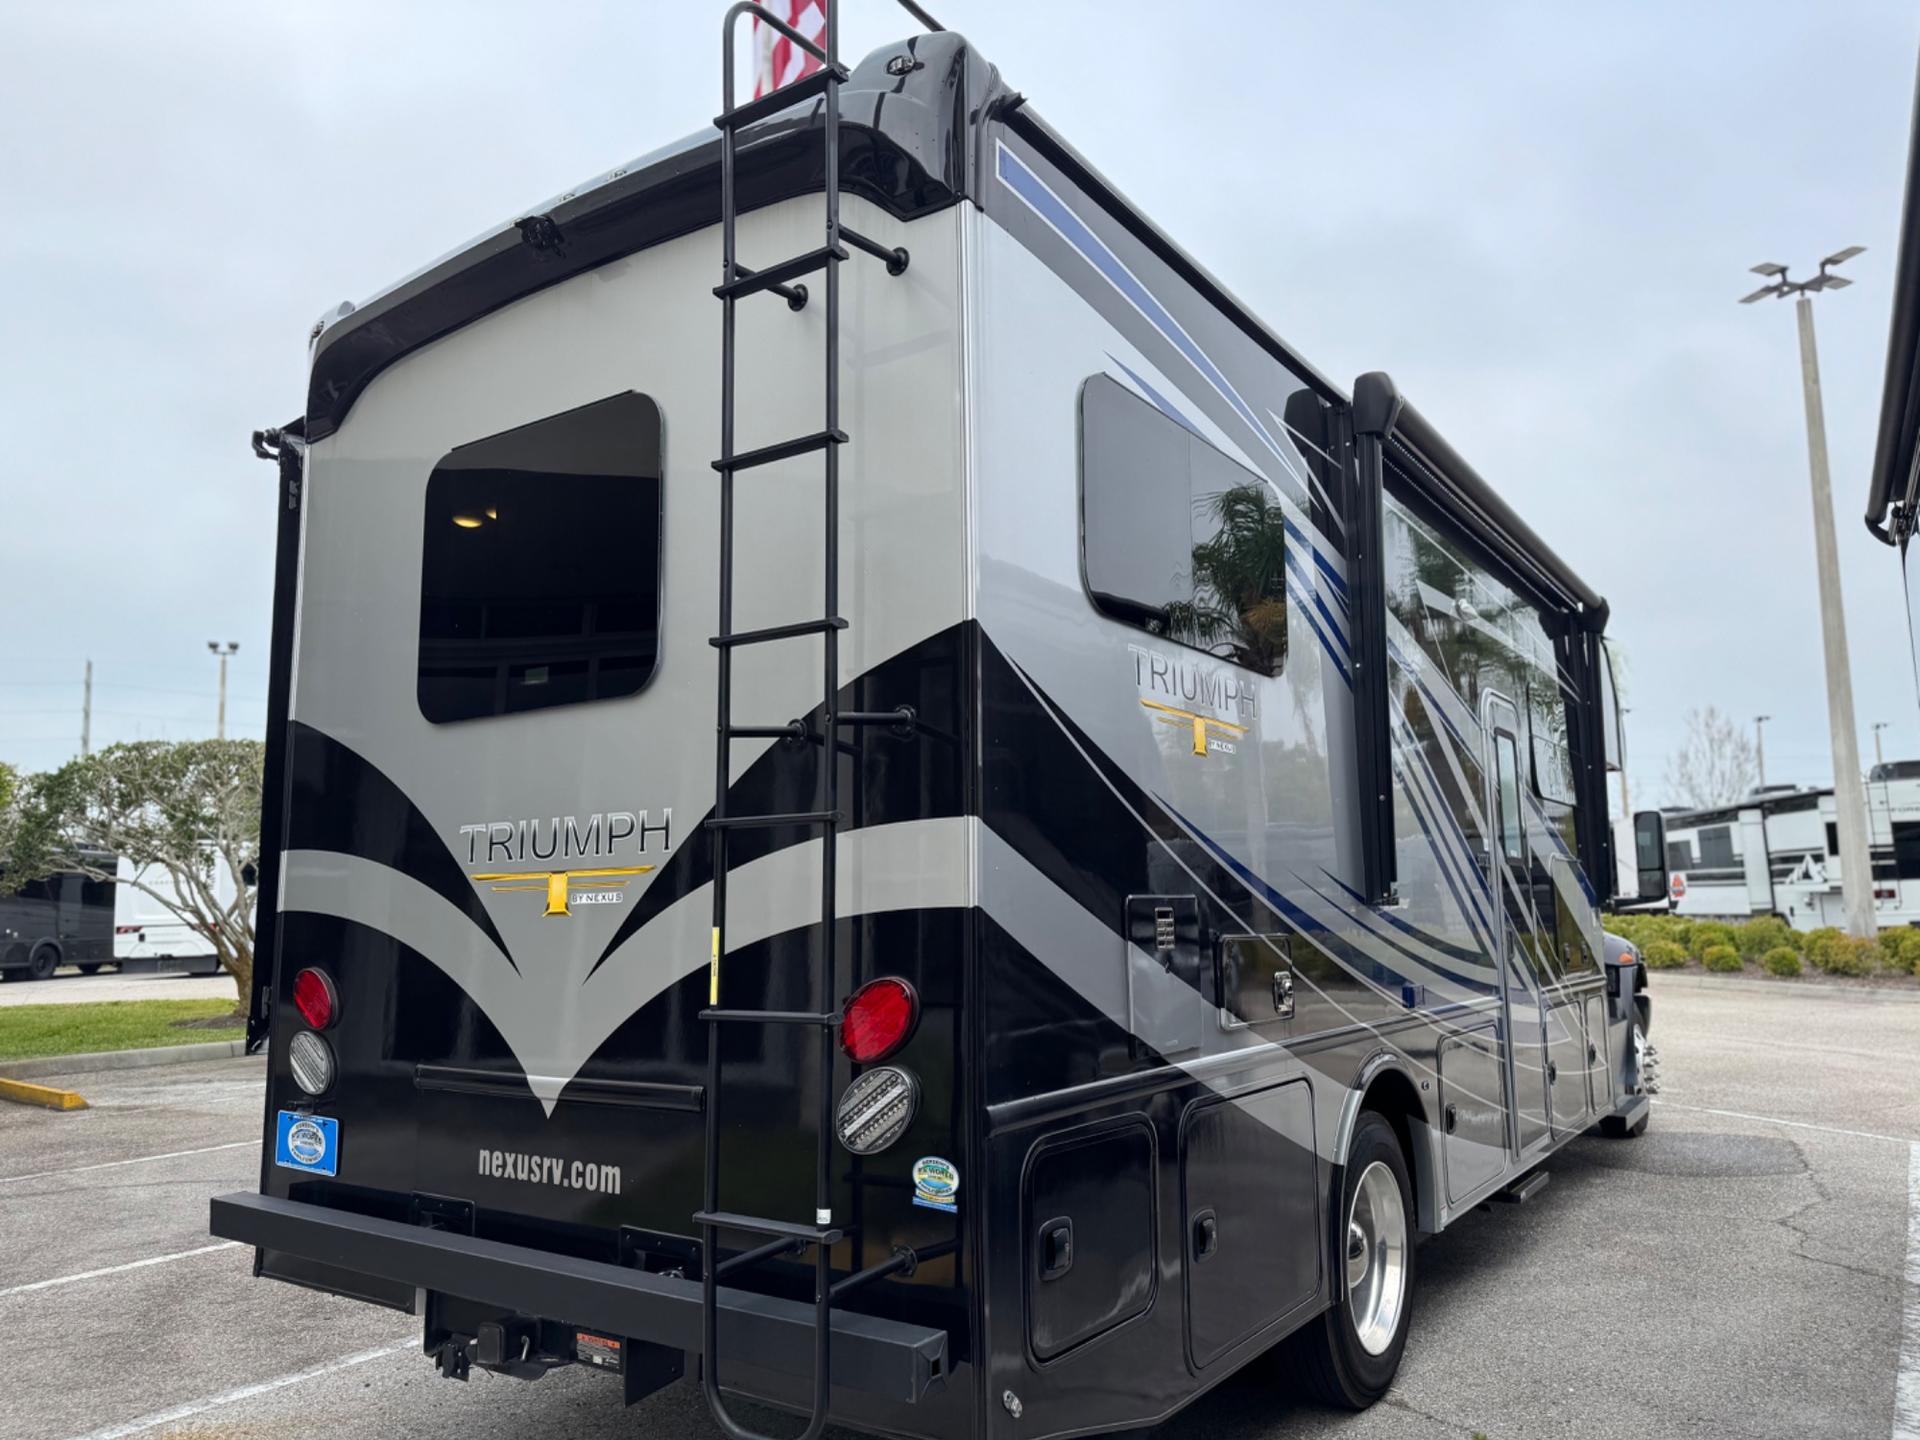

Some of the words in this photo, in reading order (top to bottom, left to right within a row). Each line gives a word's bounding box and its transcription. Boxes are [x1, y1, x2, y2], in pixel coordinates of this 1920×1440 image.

[1127, 643, 1257, 720] TRIUMPH
[459, 808, 672, 864] TRIUMPH
[572, 893, 584, 903] BY
[585, 892, 623, 903] NEXUS
[478, 1149, 621, 1195] nexusrv.com
